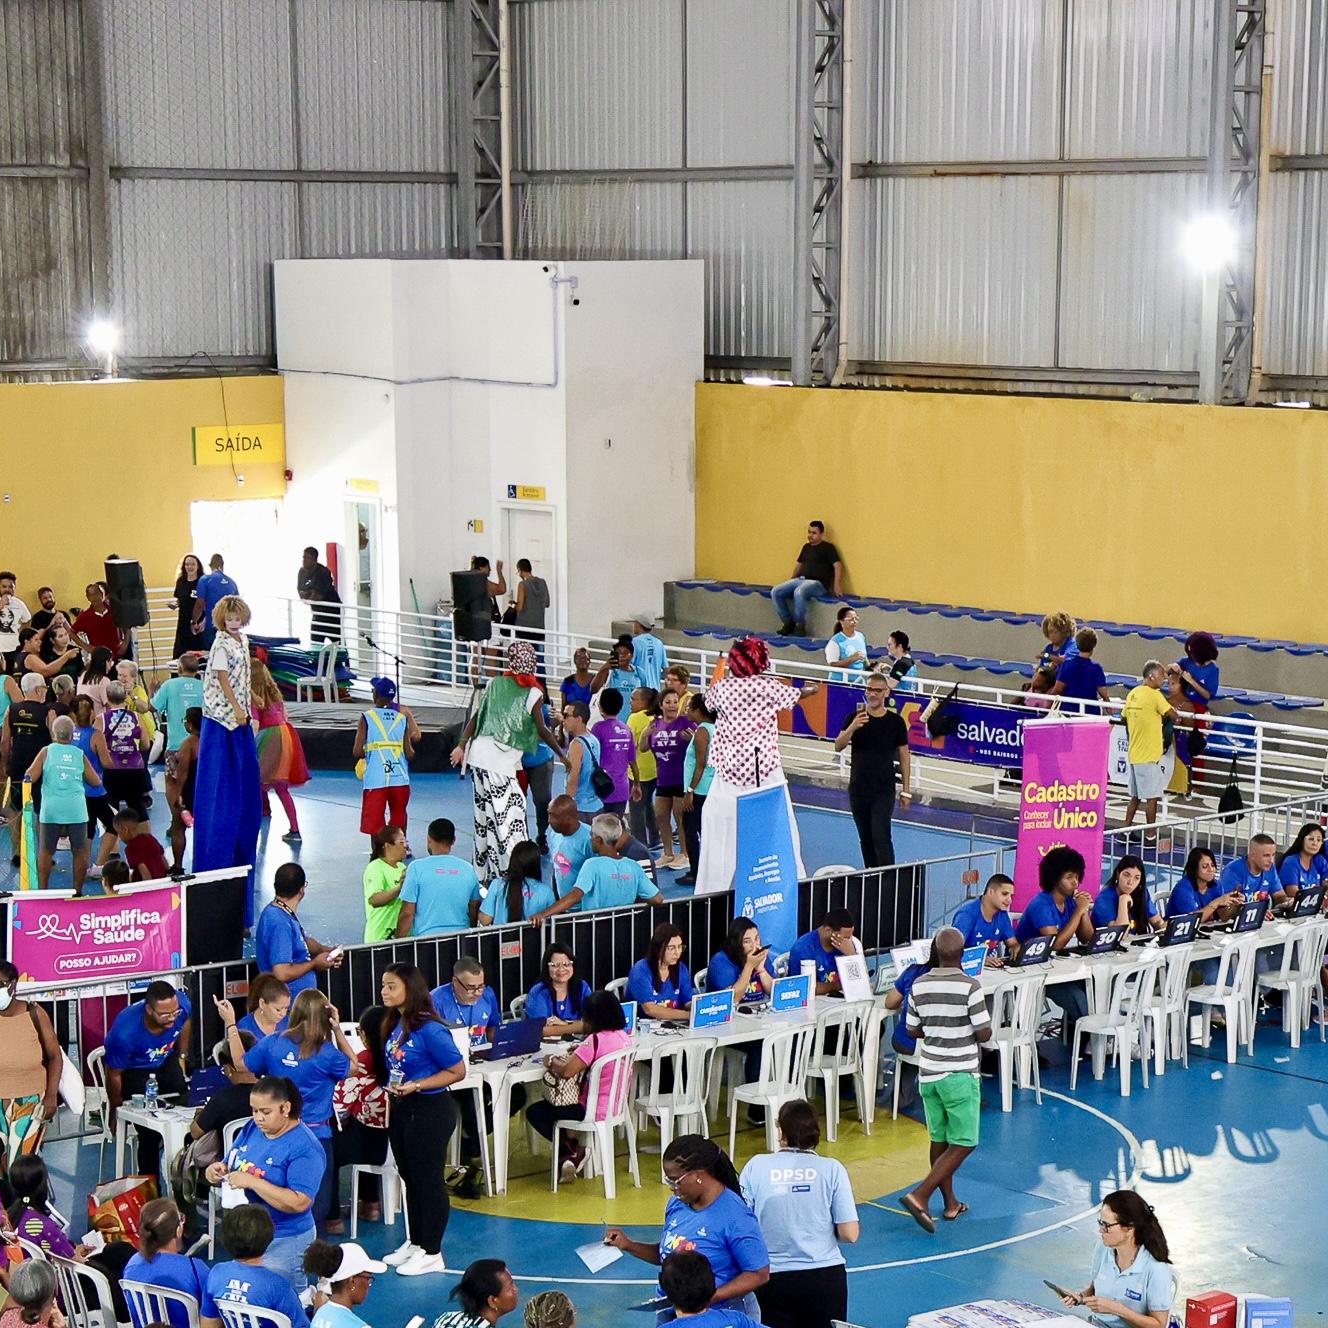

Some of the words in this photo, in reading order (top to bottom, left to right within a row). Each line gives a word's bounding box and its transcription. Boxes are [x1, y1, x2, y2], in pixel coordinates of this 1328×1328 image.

[215, 433, 263, 453] SAÍDA
[957, 720, 1024, 746] salvad
[1024, 780, 1100, 804] Cadastro
[1054, 802, 1097, 829] Único
[1300, 895, 1319, 909] 44
[79, 908, 161, 931] Simplifica
[1245, 909, 1259, 922] 11
[93, 925, 145, 945] Saúde
[1174, 920, 1190, 935] 21
[1096, 932, 1117, 945] 30
[1025, 941, 1046, 956] 49
[59, 958, 93, 970] POSSO
[93, 953, 136, 966] AJUDAR?
[771, 1168, 817, 1181] DPSD
